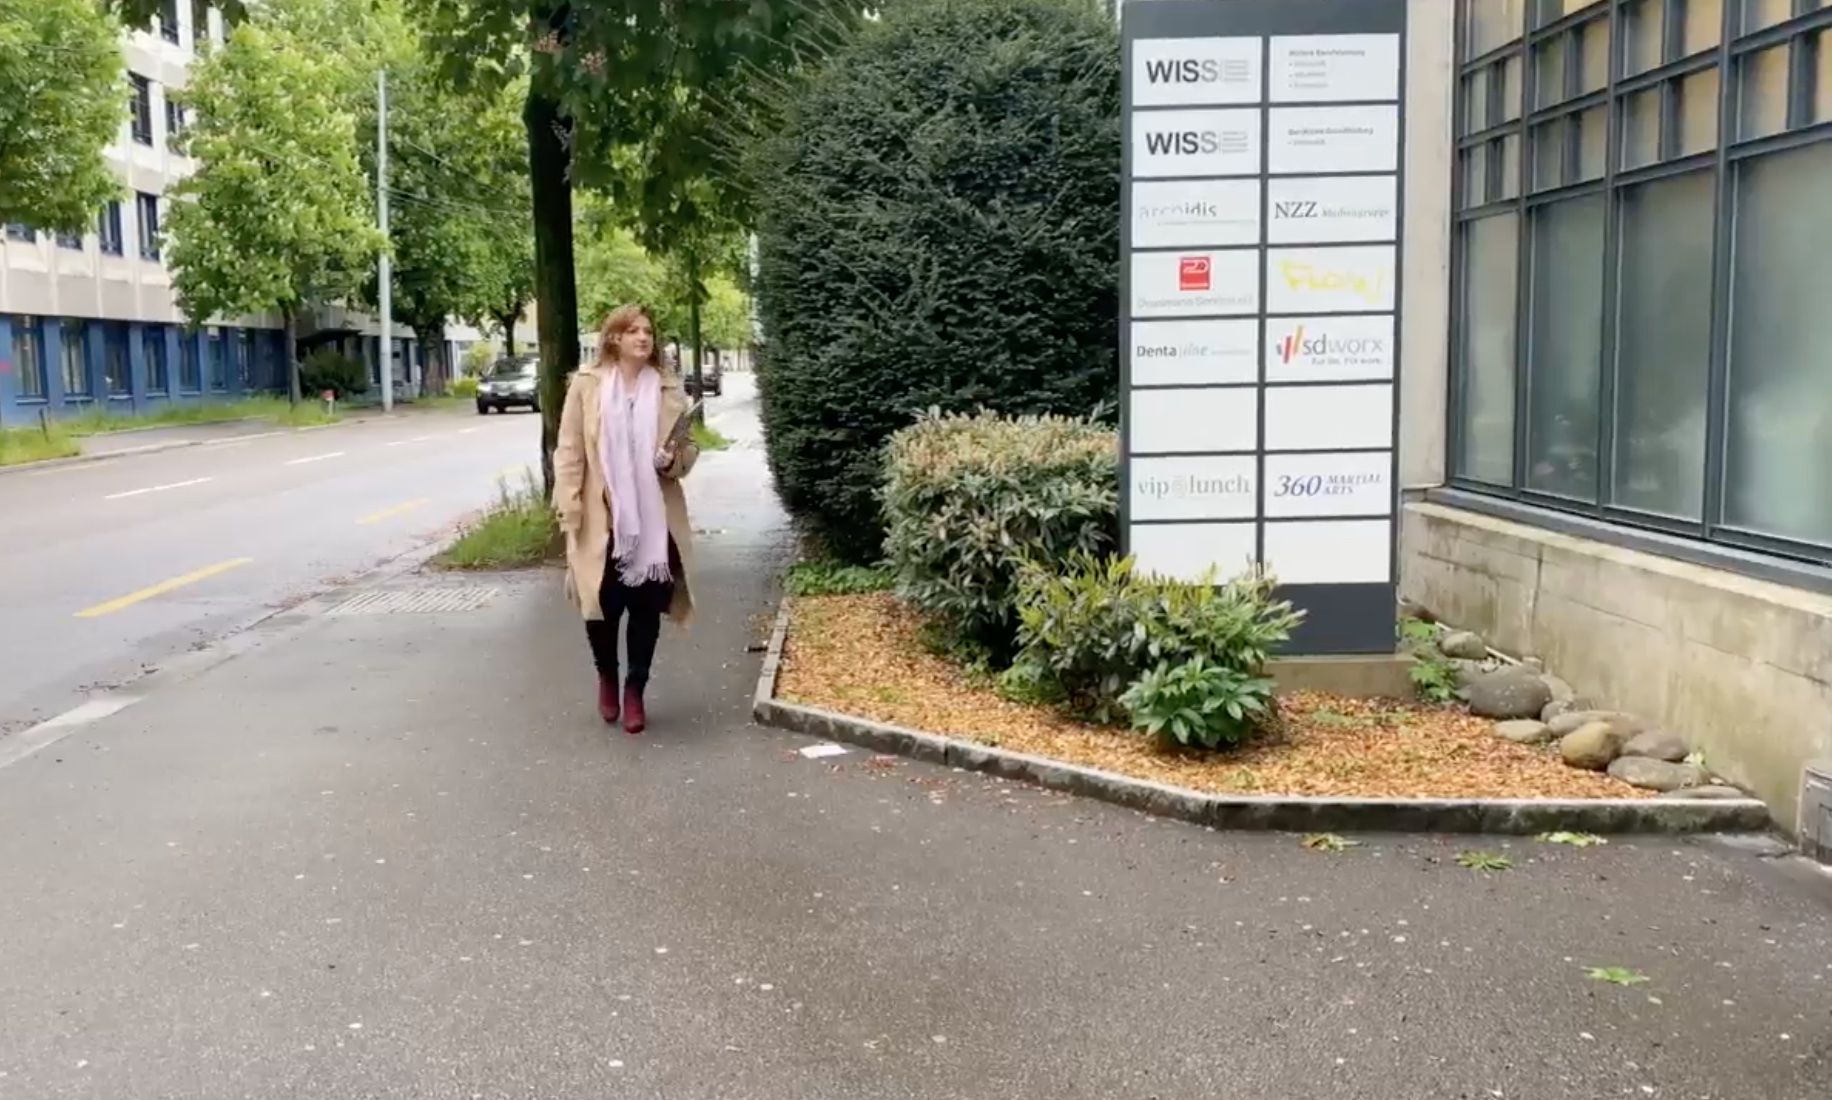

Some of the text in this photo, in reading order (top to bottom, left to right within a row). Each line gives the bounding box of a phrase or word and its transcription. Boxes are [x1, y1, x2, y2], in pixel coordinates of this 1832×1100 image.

[1146, 59, 1219, 84] WISS
[1146, 131, 1219, 155] WISS
[1274, 200, 1318, 219] NZZ
[1136, 344, 1177, 358] Denta
[1273, 473, 1323, 497] 360
[1323, 485, 1355, 495] ARTS
